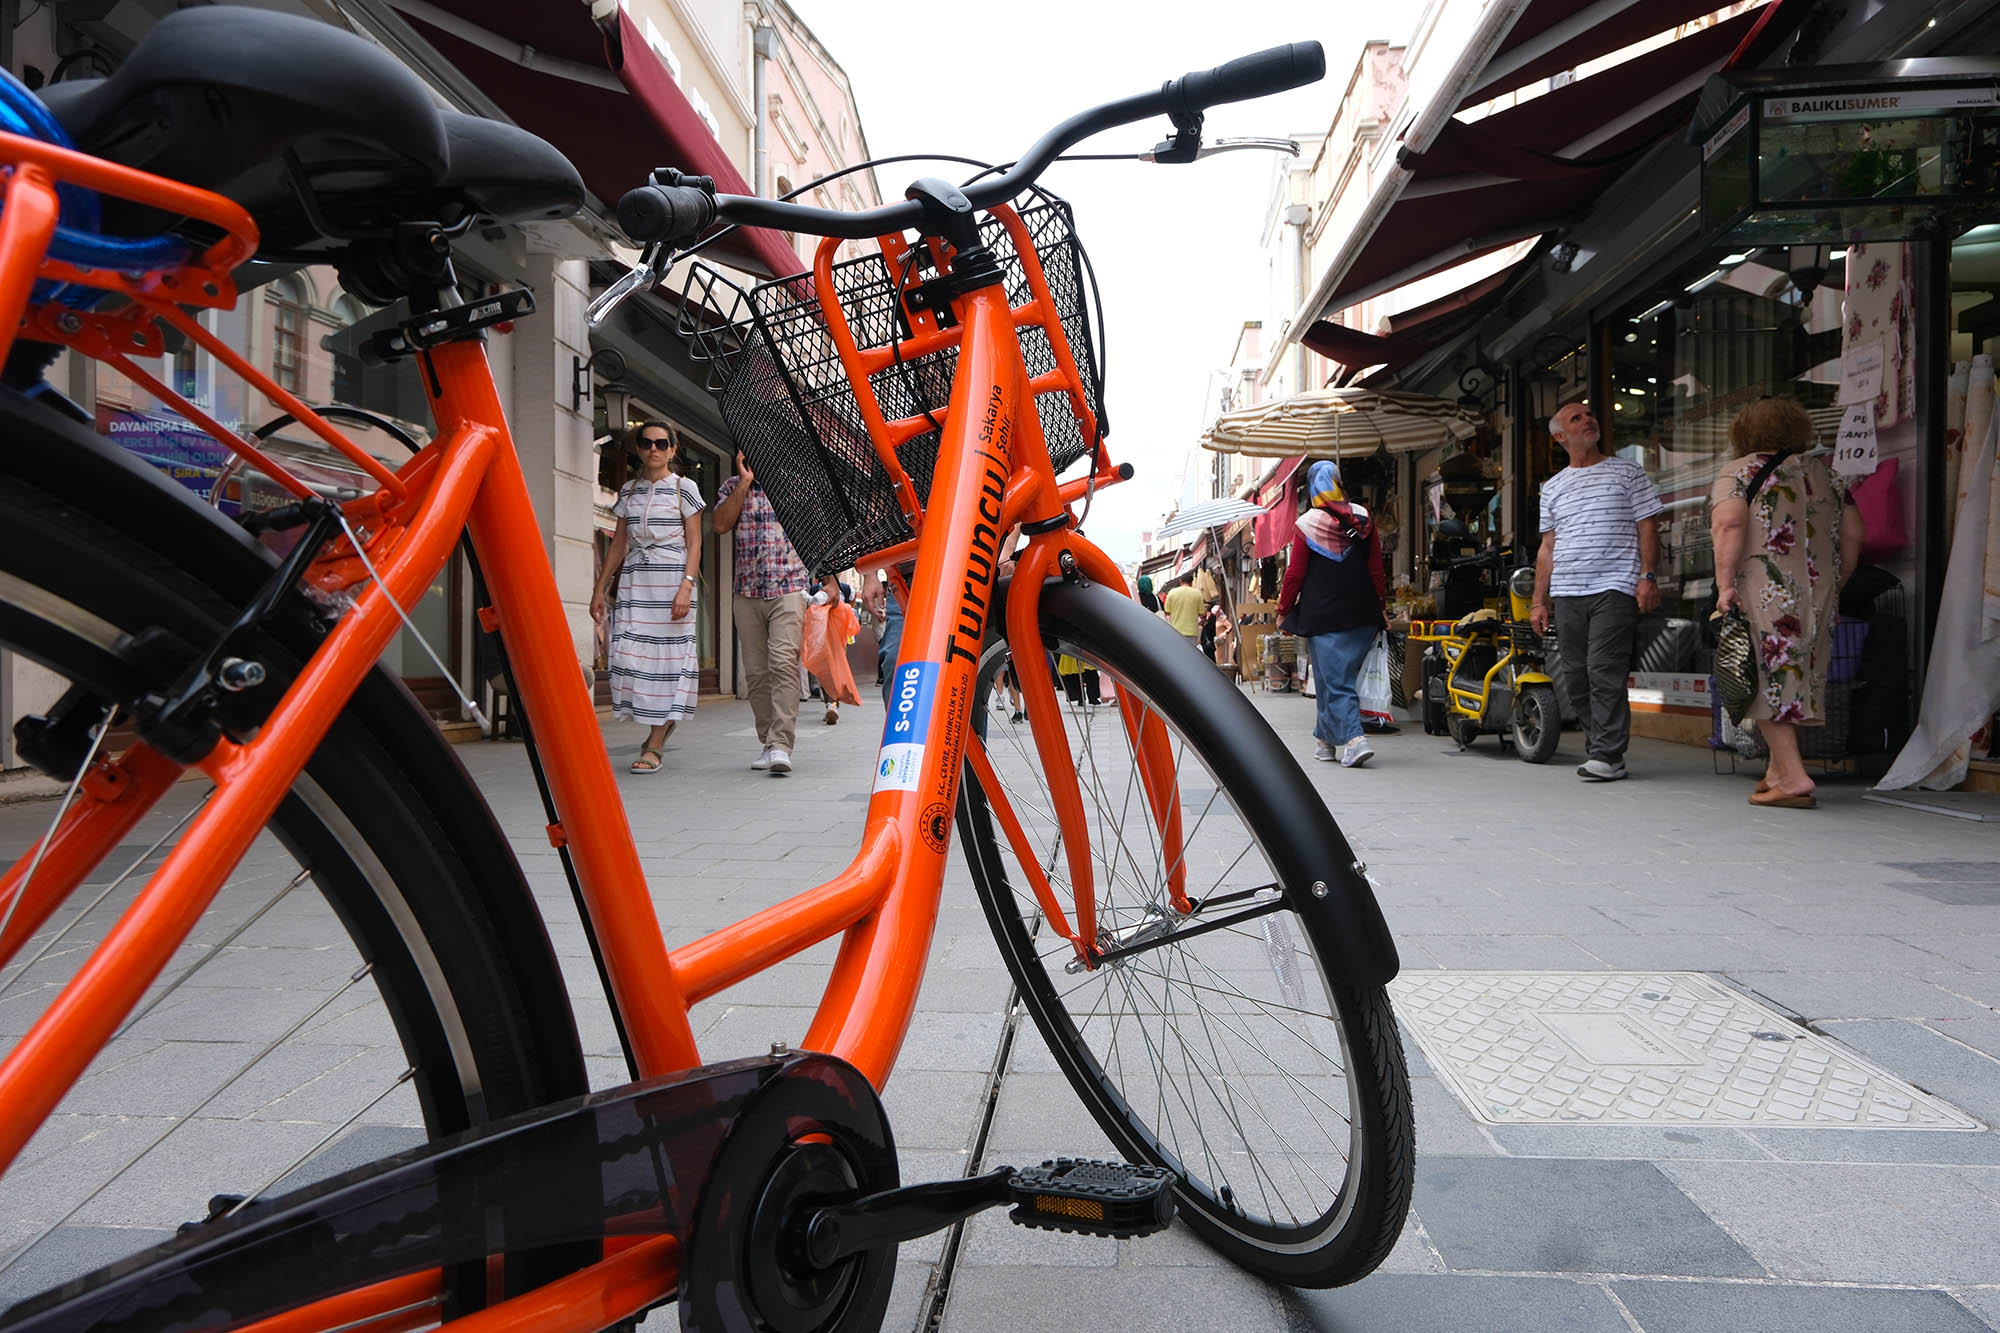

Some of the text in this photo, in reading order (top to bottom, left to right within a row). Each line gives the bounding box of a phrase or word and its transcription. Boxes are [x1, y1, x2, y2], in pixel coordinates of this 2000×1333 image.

[110, 421, 180, 434] DAYANIŞMA
[978, 384, 1003, 444] Sakarya
[996, 413, 1011, 455] Şehir
[945, 468, 1006, 665] Turuncu
[894, 667, 920, 732] S-0016
[944, 698, 956, 747] ŞEHİRCİLİK
[951, 686, 959, 697] VE
